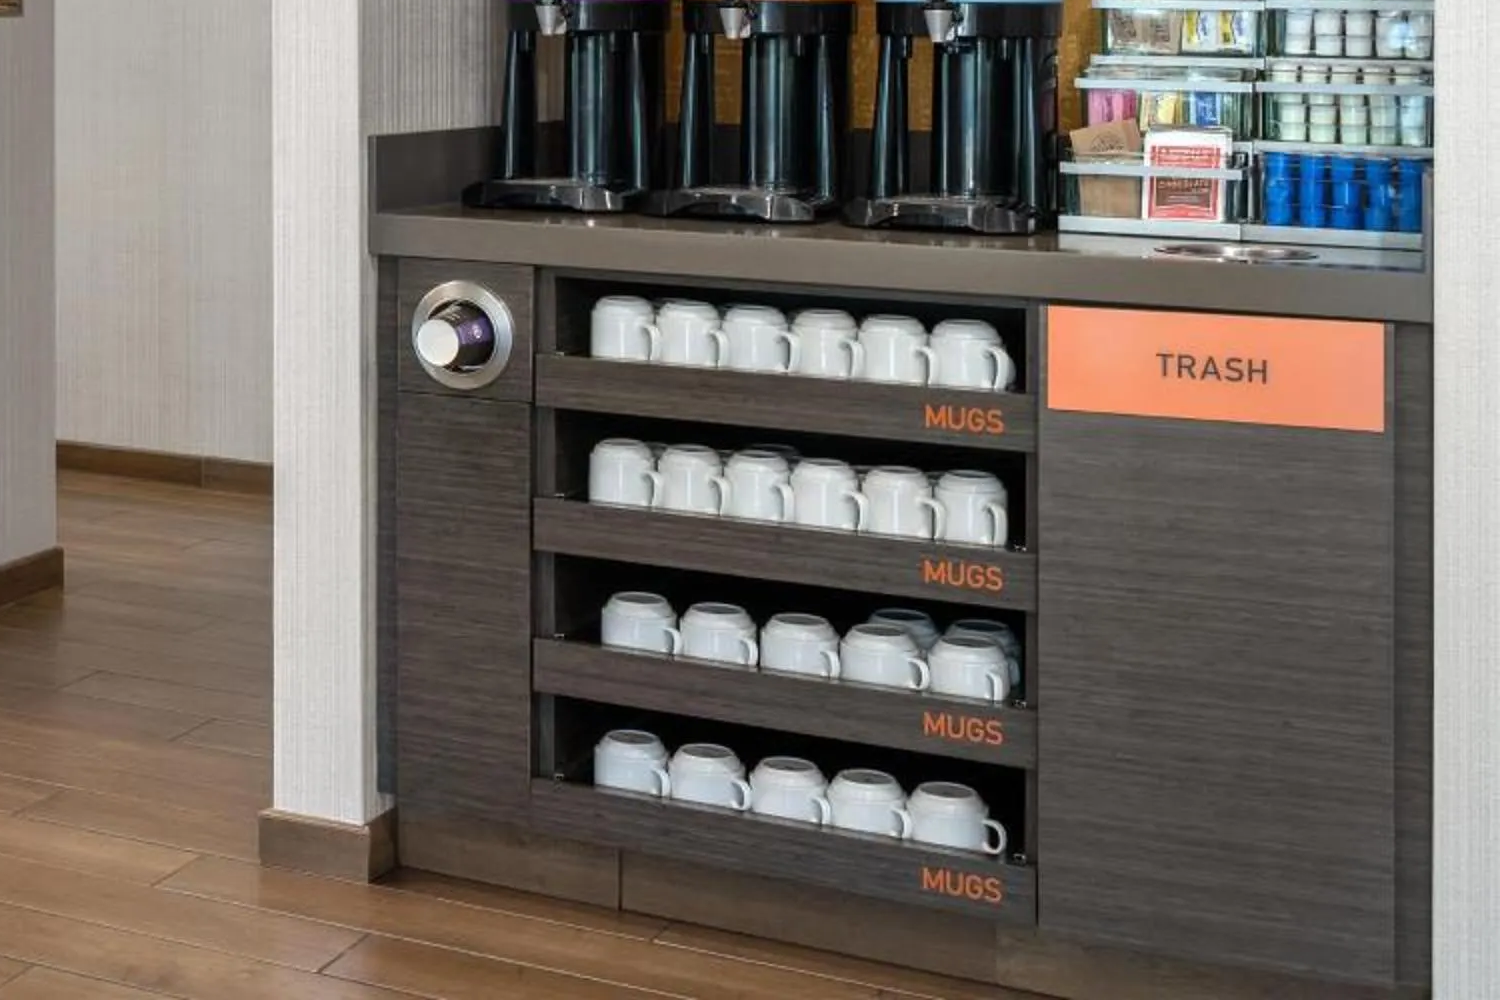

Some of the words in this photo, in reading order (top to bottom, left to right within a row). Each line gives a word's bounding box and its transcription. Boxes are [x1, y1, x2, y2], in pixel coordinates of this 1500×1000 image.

[1156, 353, 1268, 384] TRASH
[925, 404, 1004, 434] MUGS
[924, 559, 1003, 591] MUGS
[923, 711, 1003, 745] MUGS
[922, 867, 1002, 902] MUGS
